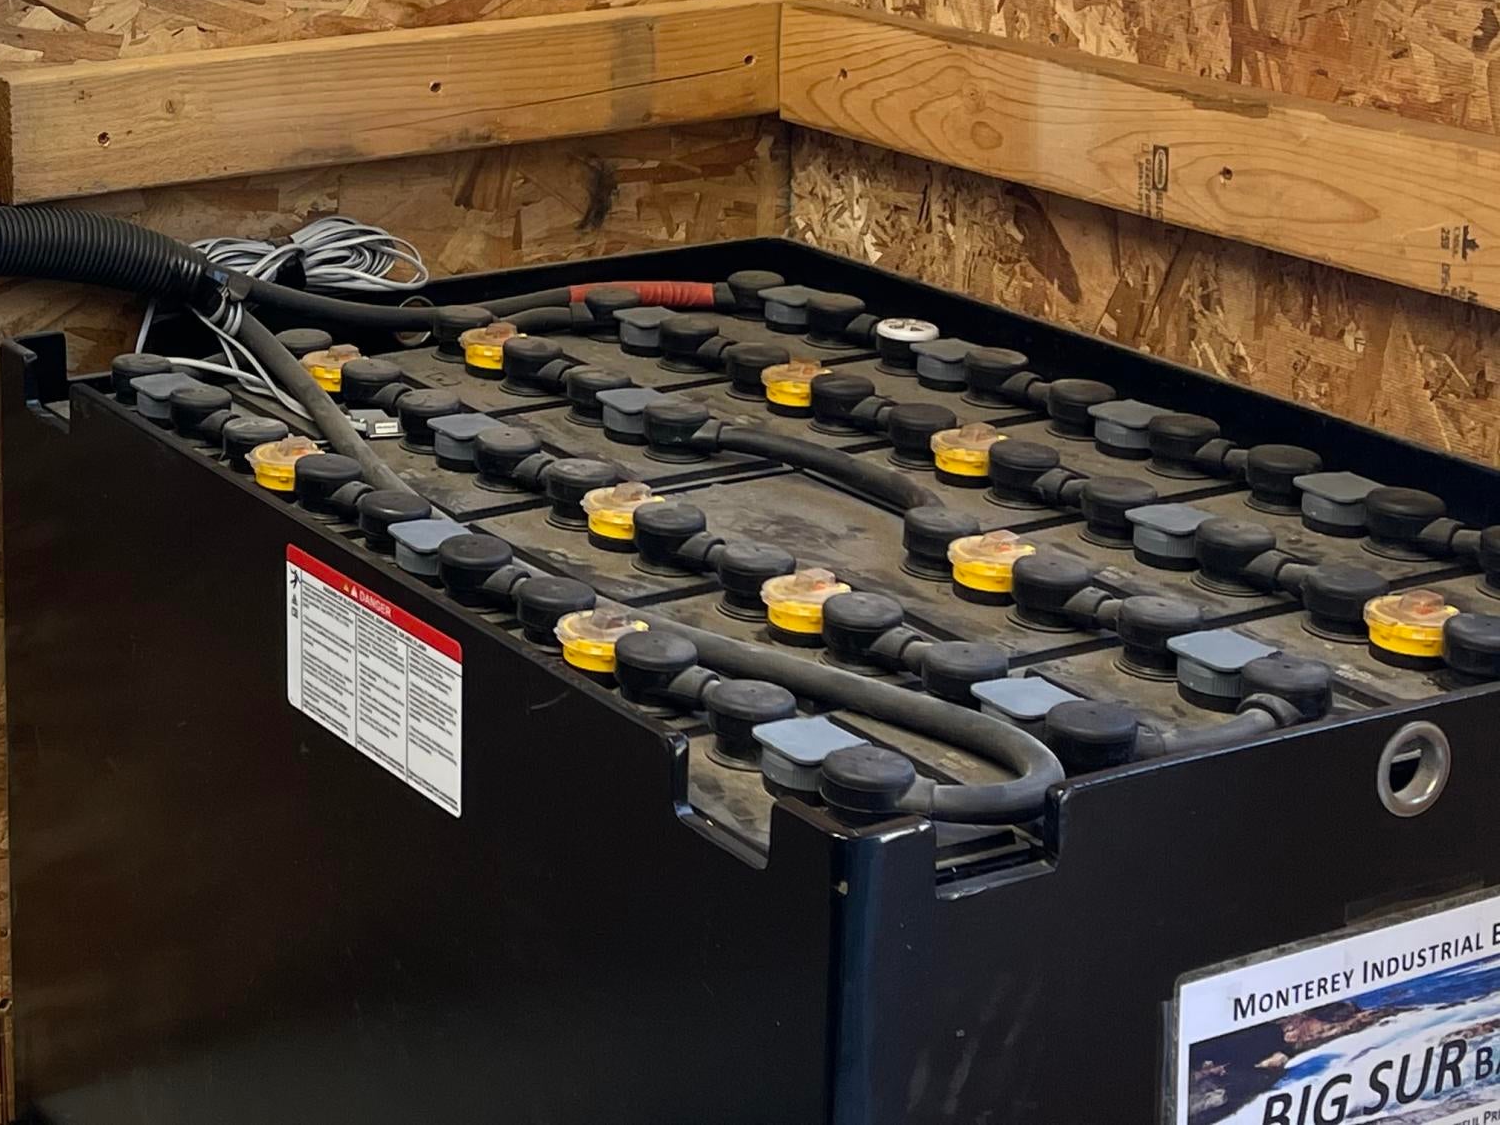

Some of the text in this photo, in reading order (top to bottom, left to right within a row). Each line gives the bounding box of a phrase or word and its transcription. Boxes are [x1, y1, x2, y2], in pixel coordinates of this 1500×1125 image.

[359, 589, 392, 619] DANGER
[1233, 968, 1354, 1022] MONTEREY
[1363, 933, 1484, 985] INDUSTRIAL
[1261, 1038, 1500, 1125] BIG SUR B
